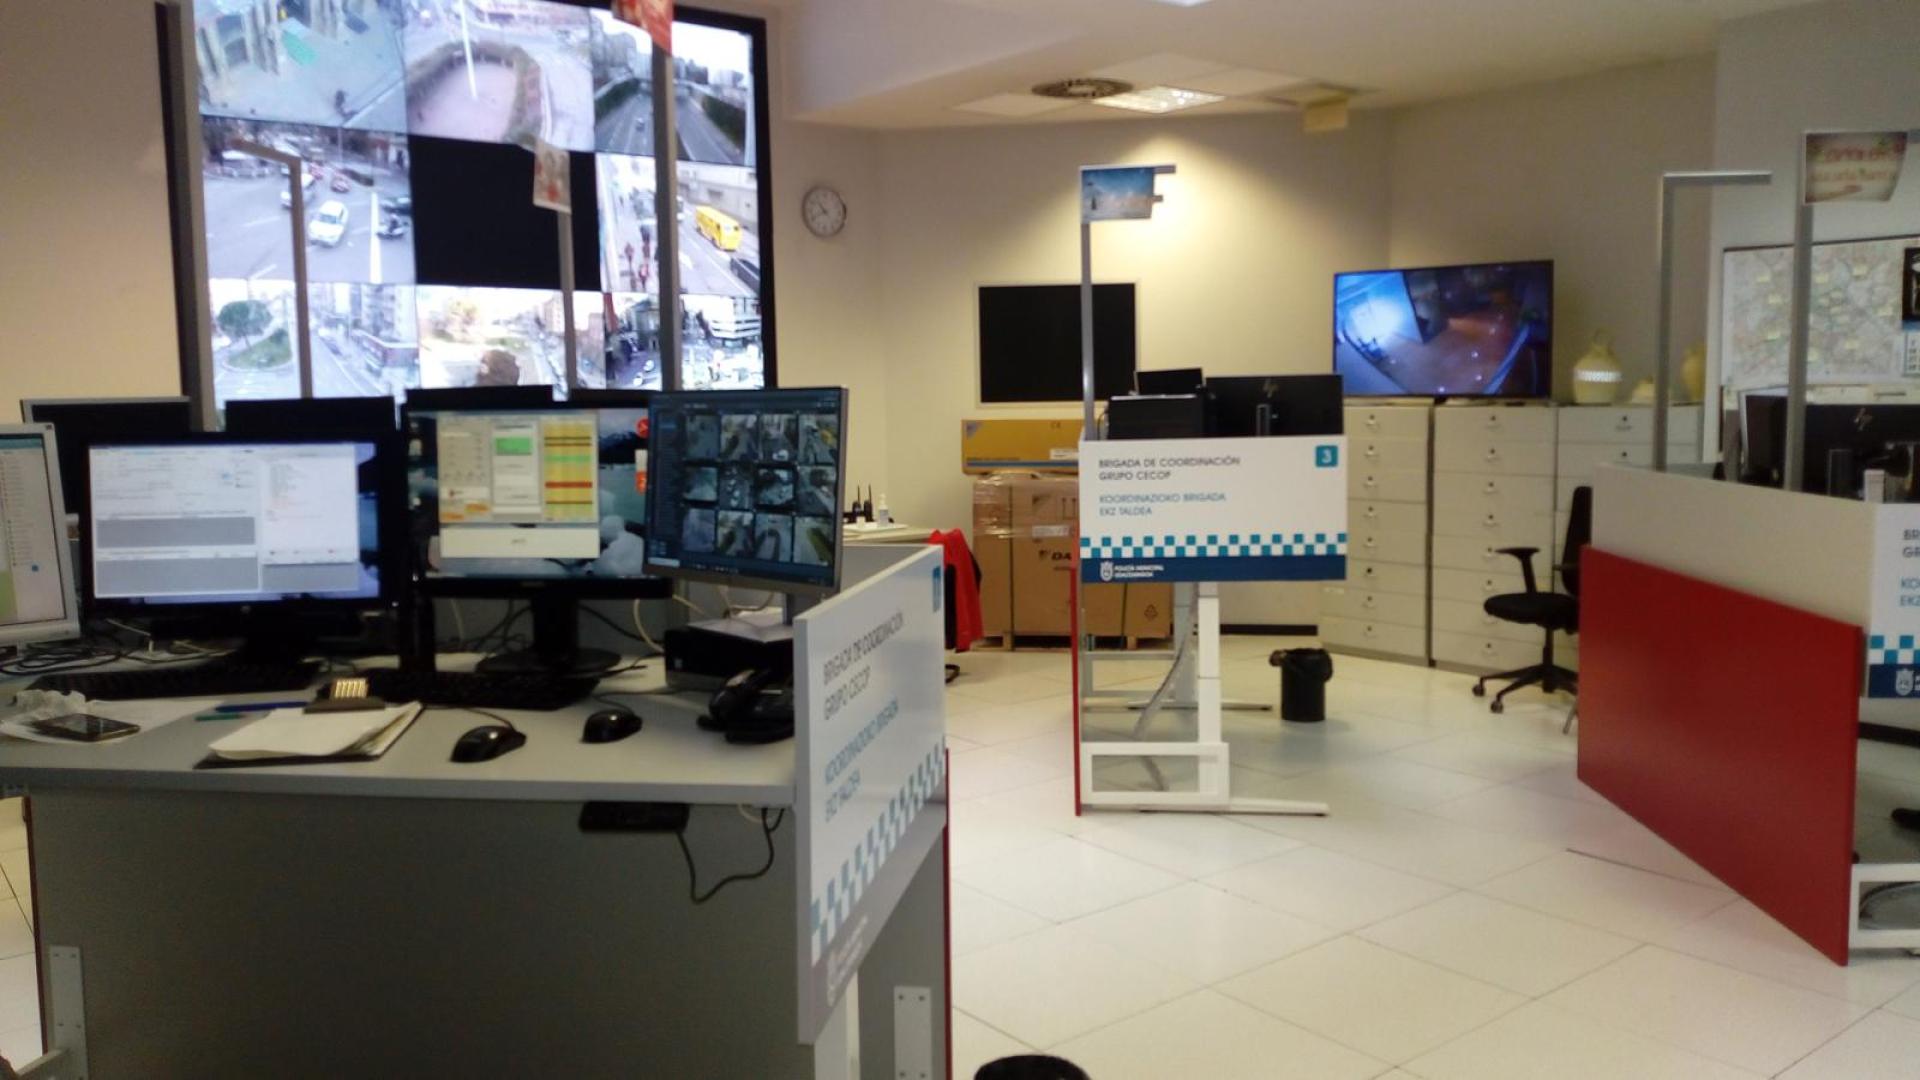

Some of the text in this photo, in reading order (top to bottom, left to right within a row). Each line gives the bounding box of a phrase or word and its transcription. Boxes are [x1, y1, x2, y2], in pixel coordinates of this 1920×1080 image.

[1099, 458, 1141, 468] BRIGADA
[1143, 458, 1156, 467] DE
[1099, 470, 1171, 481] GRUPO CECOP
[1119, 506, 1152, 516] TALDEA
